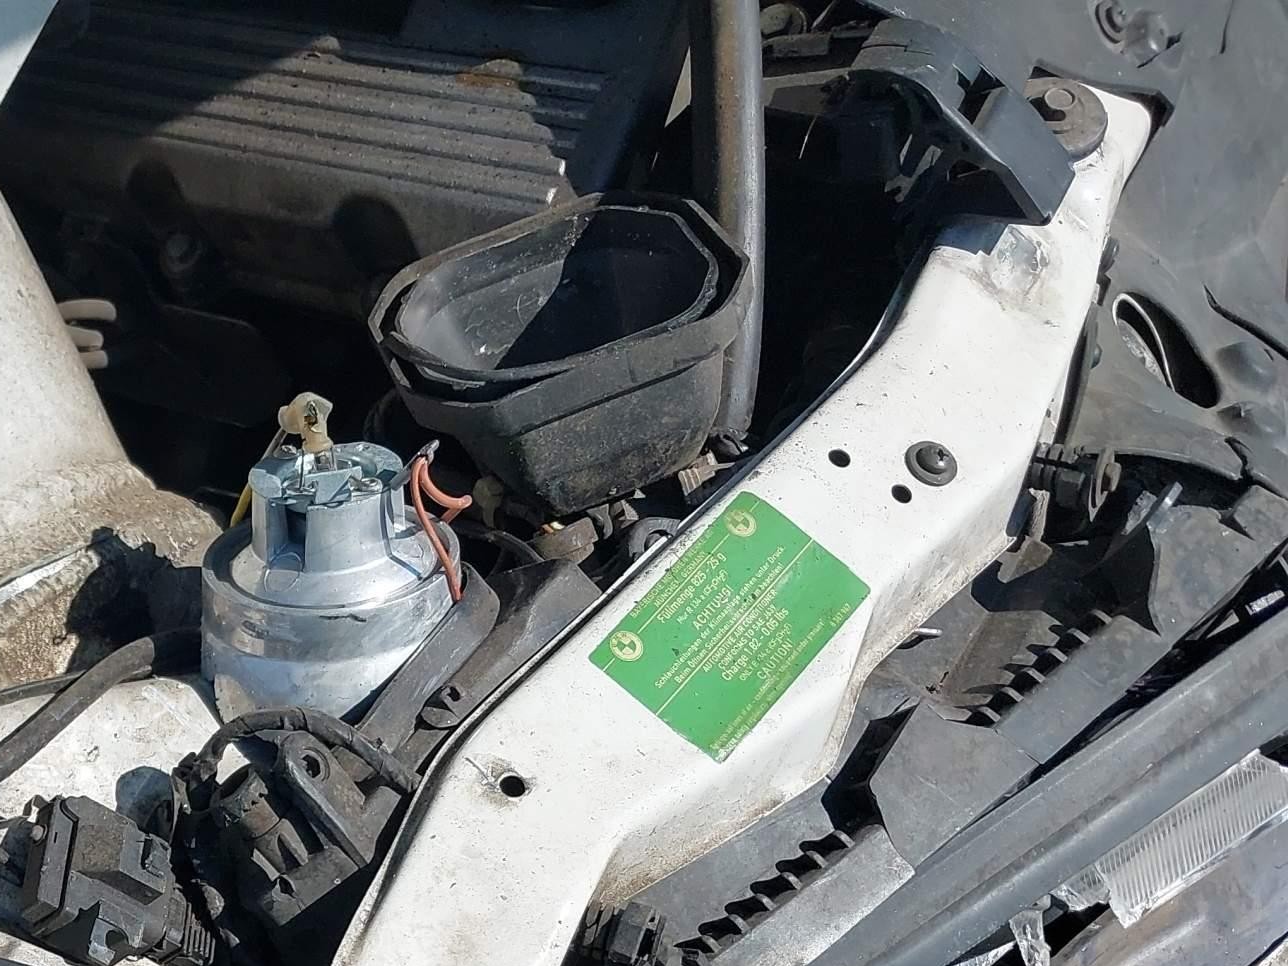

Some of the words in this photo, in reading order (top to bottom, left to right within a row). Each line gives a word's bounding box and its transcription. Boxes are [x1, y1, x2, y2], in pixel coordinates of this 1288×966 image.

[656, 583, 697, 625] Füllmenge
[689, 570, 707, 587] 825
[706, 556, 720, 569] 25
[716, 552, 727, 562] g
[689, 583, 735, 630] ACHTUNG!
[653, 636, 704, 690] Schlauchleitungen
[698, 626, 711, 639] der
[707, 593, 742, 630] Klimaanlage
[700, 634, 736, 672] AUTOMOTIVE
[732, 624, 745, 637] AIR
[741, 588, 778, 628] CONDITIONER
[720, 651, 750, 683] Charge
[743, 637, 762, 656] 1.82
[760, 617, 780, 637] 0.05
[773, 606, 790, 622] lbs
[751, 616, 766, 631] SAE
[673, 665, 691, 683] Beim
[755, 637, 795, 680] CAUTION!
